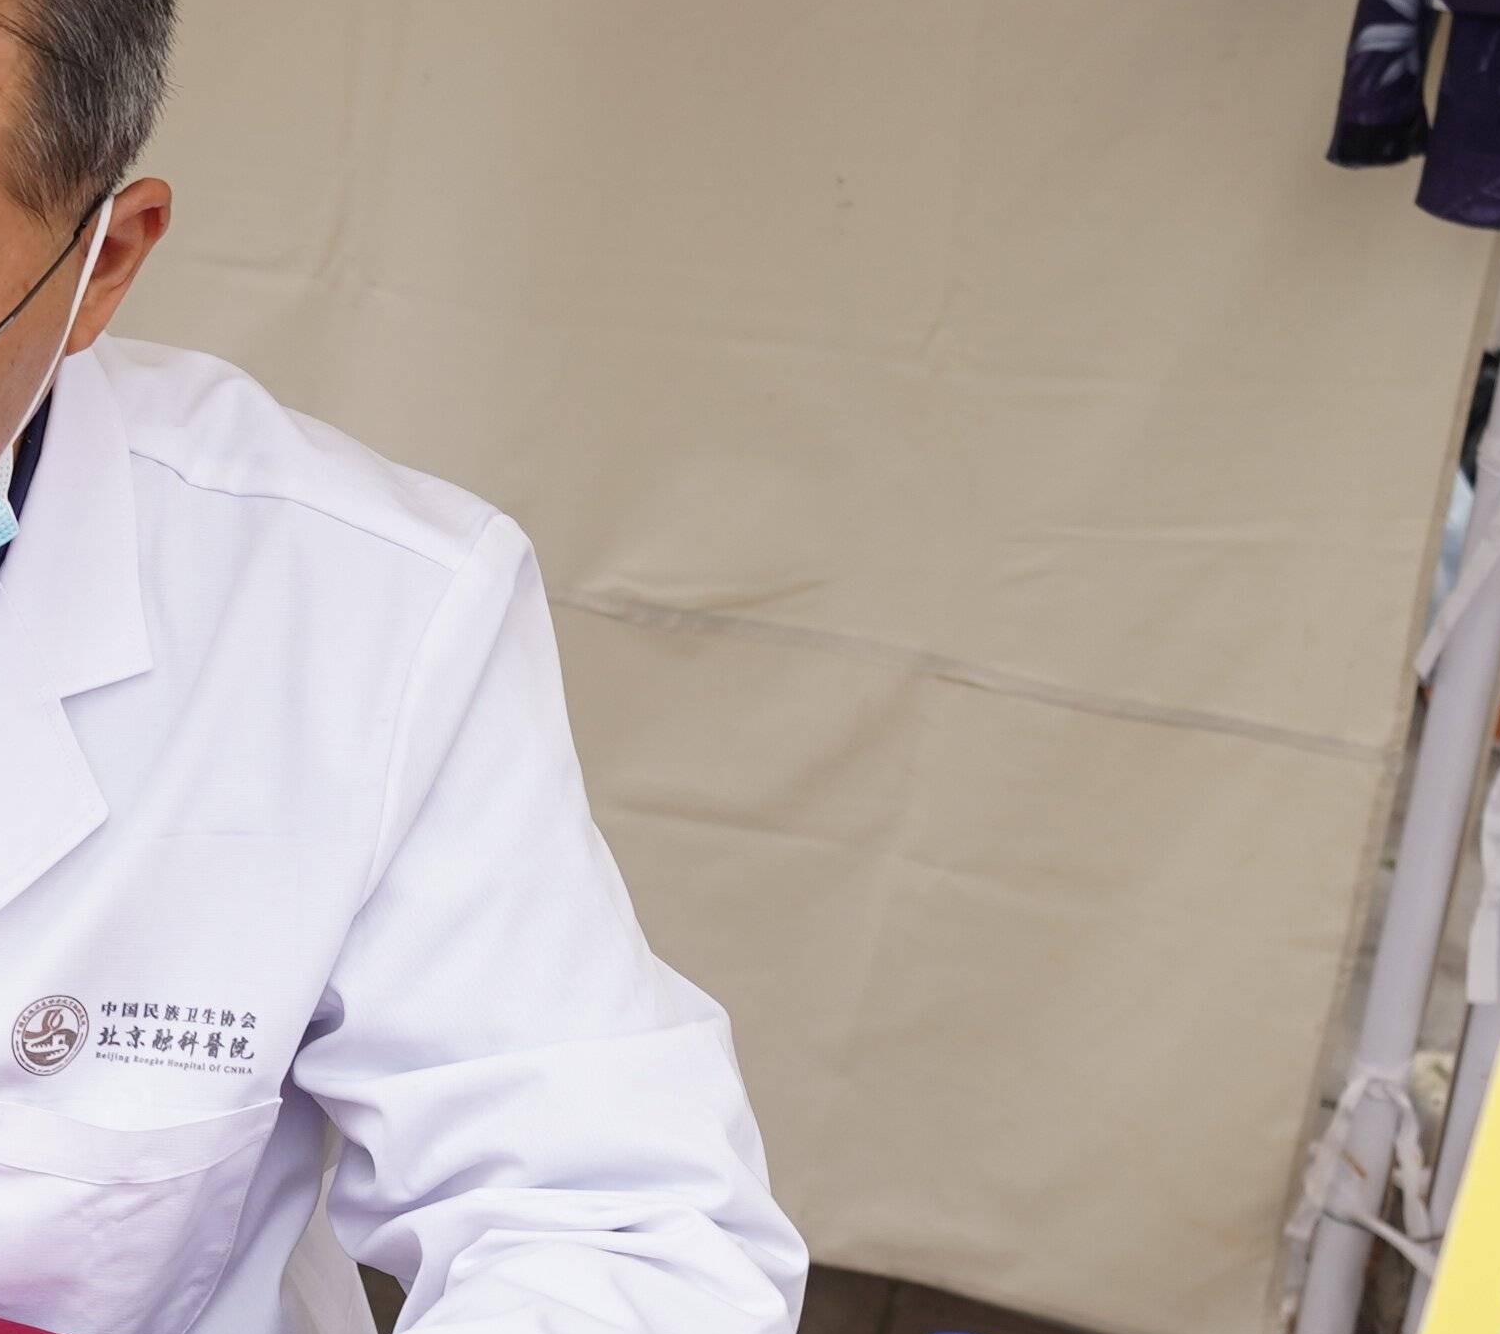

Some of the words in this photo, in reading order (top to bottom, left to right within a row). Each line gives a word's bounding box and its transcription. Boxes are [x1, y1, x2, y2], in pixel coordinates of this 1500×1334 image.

[101, 1001, 257, 1029] 中国民族卫生协会
[95, 1051, 130, 1064] Beijing
[167, 1058, 206, 1071] Hospital
